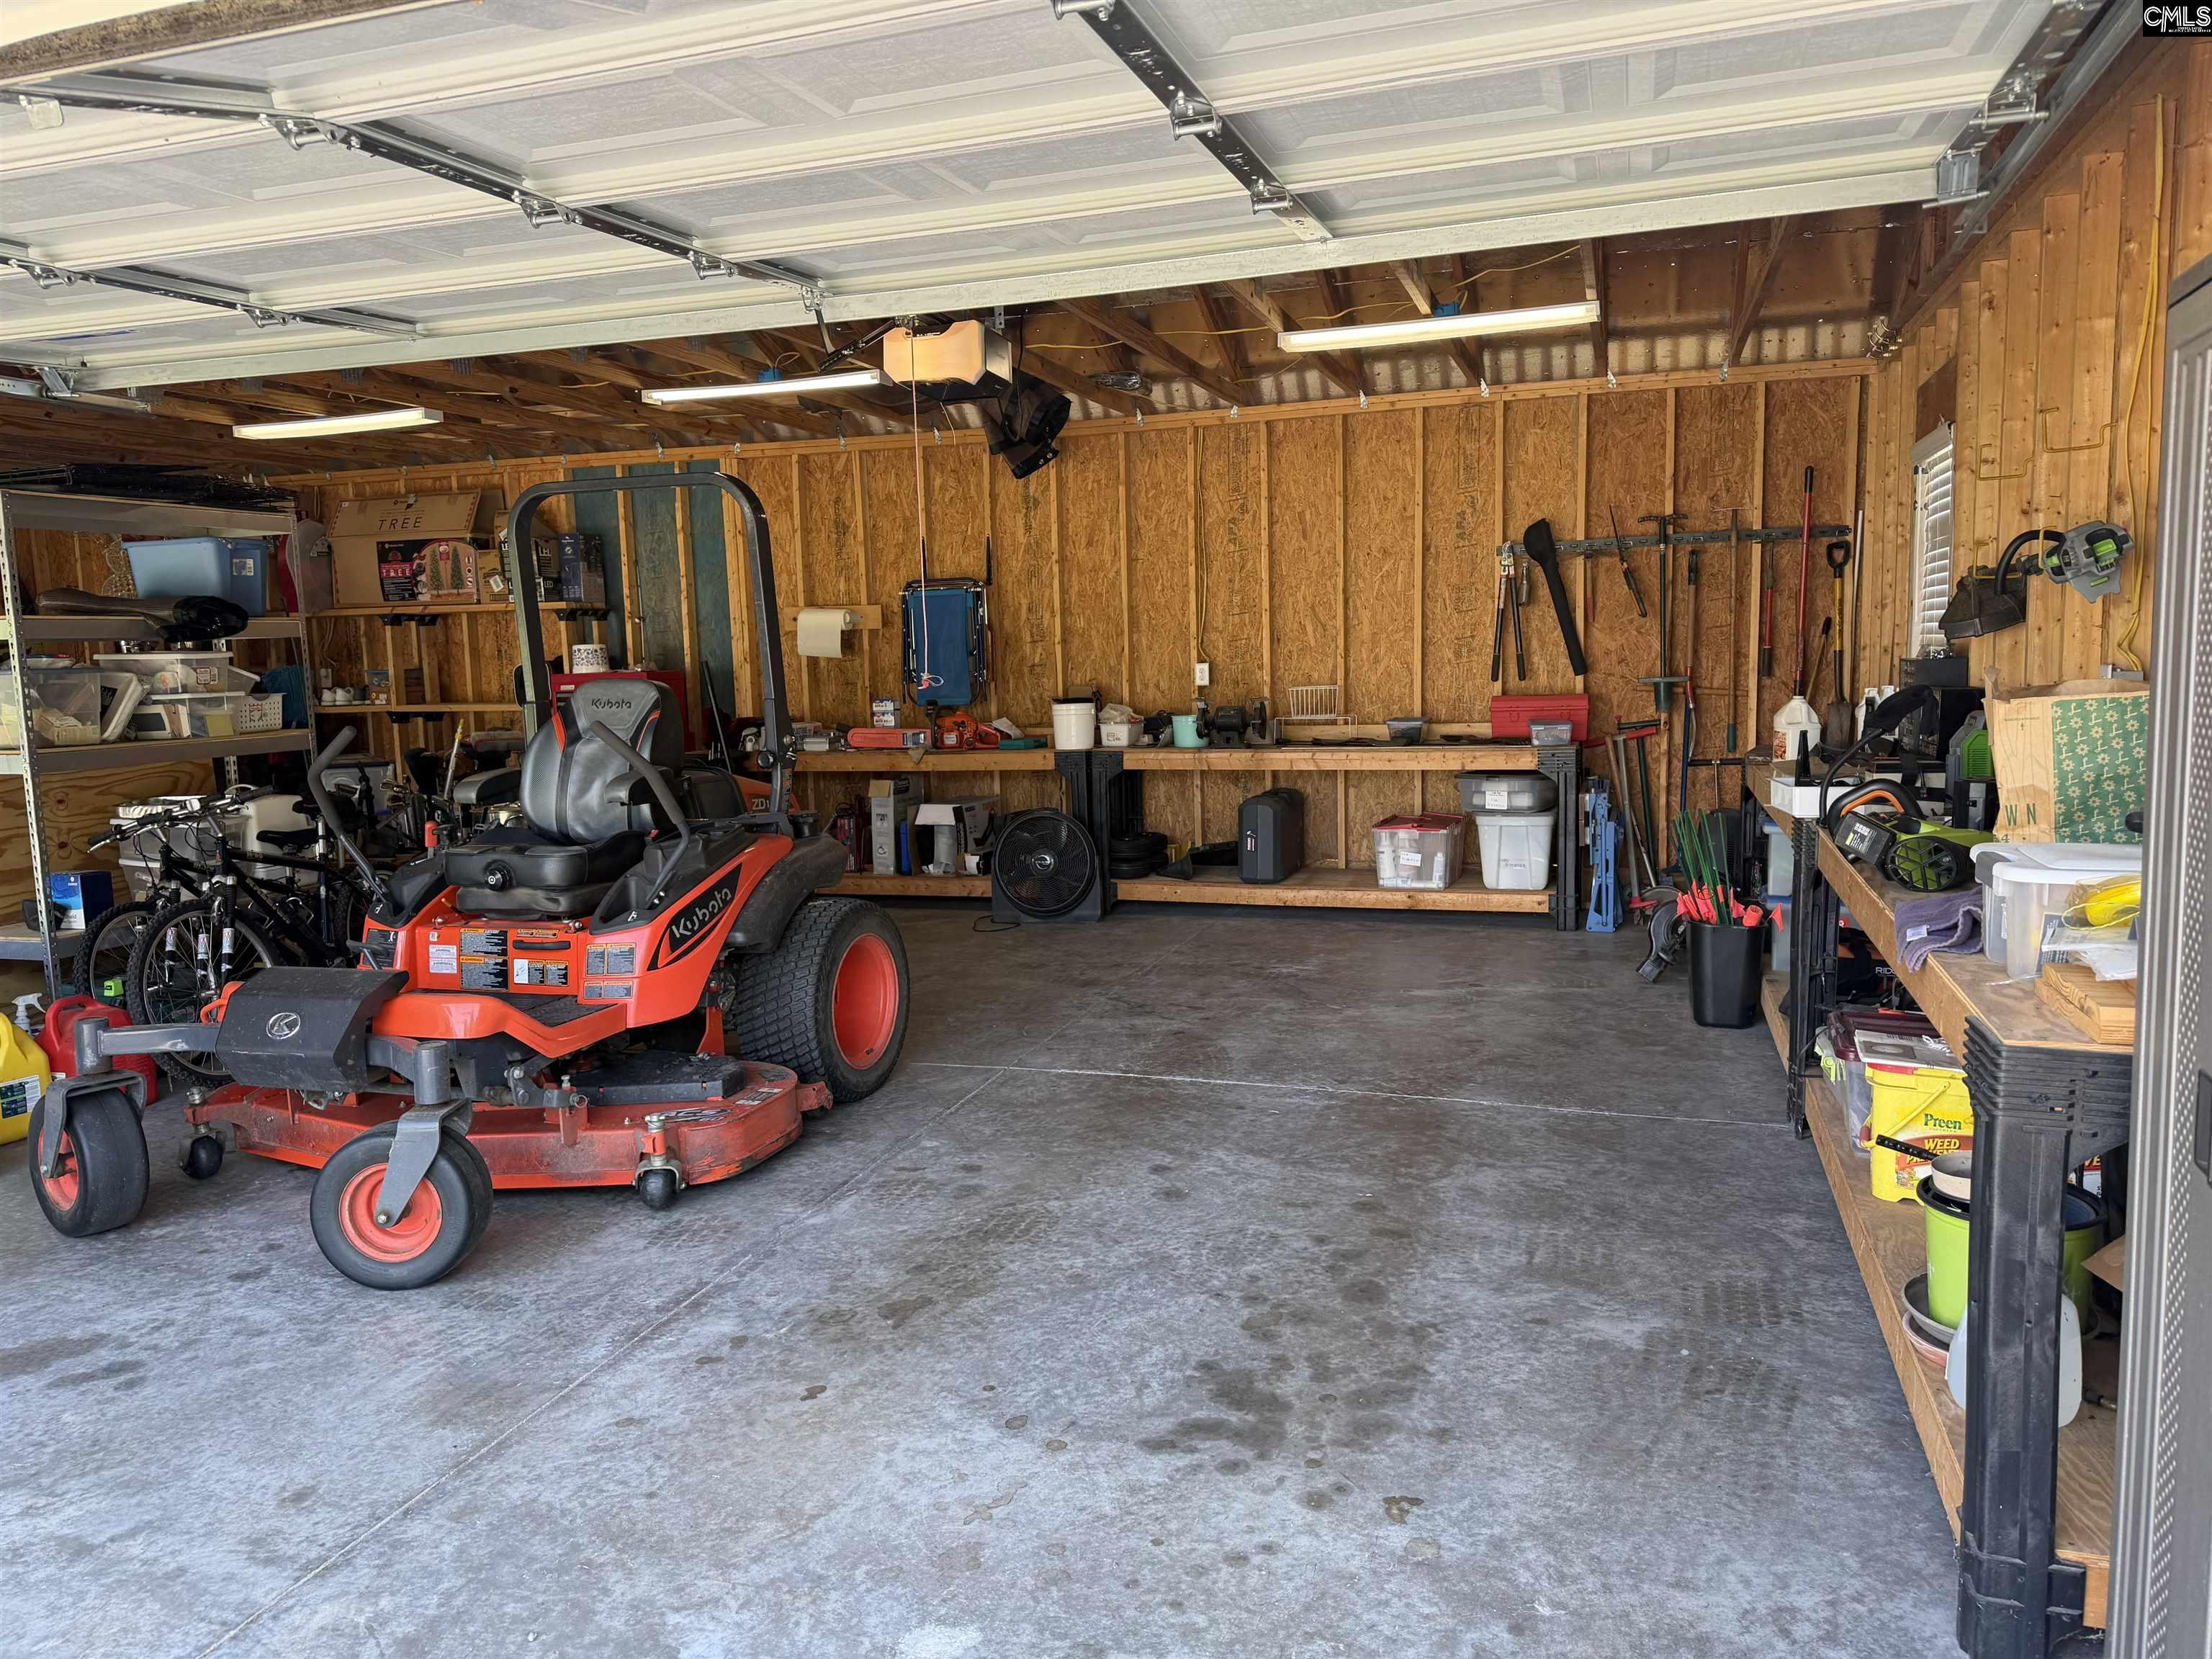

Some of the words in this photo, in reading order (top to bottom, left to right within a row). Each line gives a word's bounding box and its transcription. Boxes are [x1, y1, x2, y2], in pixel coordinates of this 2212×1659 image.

[378, 516, 423, 531] TREE
[591, 698, 631, 709] Kubota
[751, 798, 770, 811] ZD1
[2004, 803, 2037, 827] WN
[671, 888, 732, 938] Kubota
[1924, 1112, 1962, 1130] Preen
[1923, 1138, 1960, 1150] WEED
